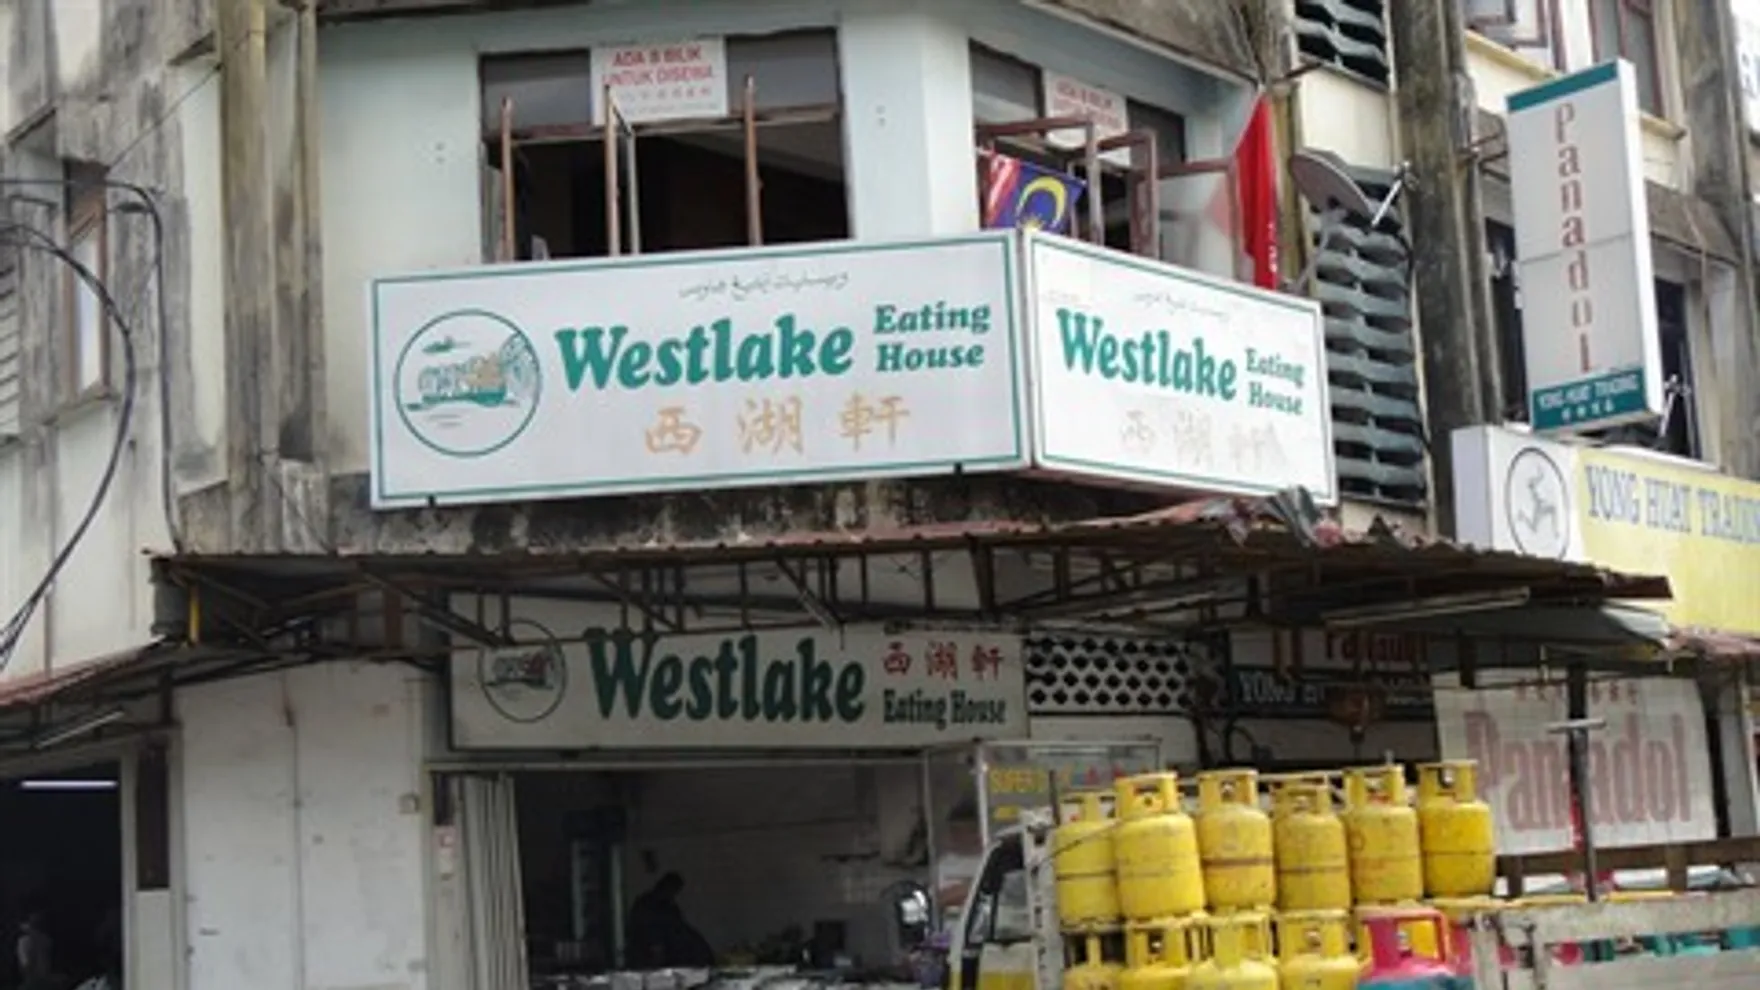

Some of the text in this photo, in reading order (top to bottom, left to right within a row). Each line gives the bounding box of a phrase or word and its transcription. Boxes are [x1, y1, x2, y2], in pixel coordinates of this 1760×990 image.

[1554, 101, 1592, 373] Panadol
[873, 300, 991, 335] Eating
[553, 314, 855, 391] Westlake
[875, 341, 985, 373] House
[1055, 307, 1238, 402] Westlake
[1245, 346, 1306, 388] Eating
[1248, 381, 1304, 416] House
[1585, 463, 1640, 526] YONG
[1644, 476, 1692, 535] HUAT
[583, 627, 866, 723] Westlake
[883, 688, 1007, 731] Eating House
